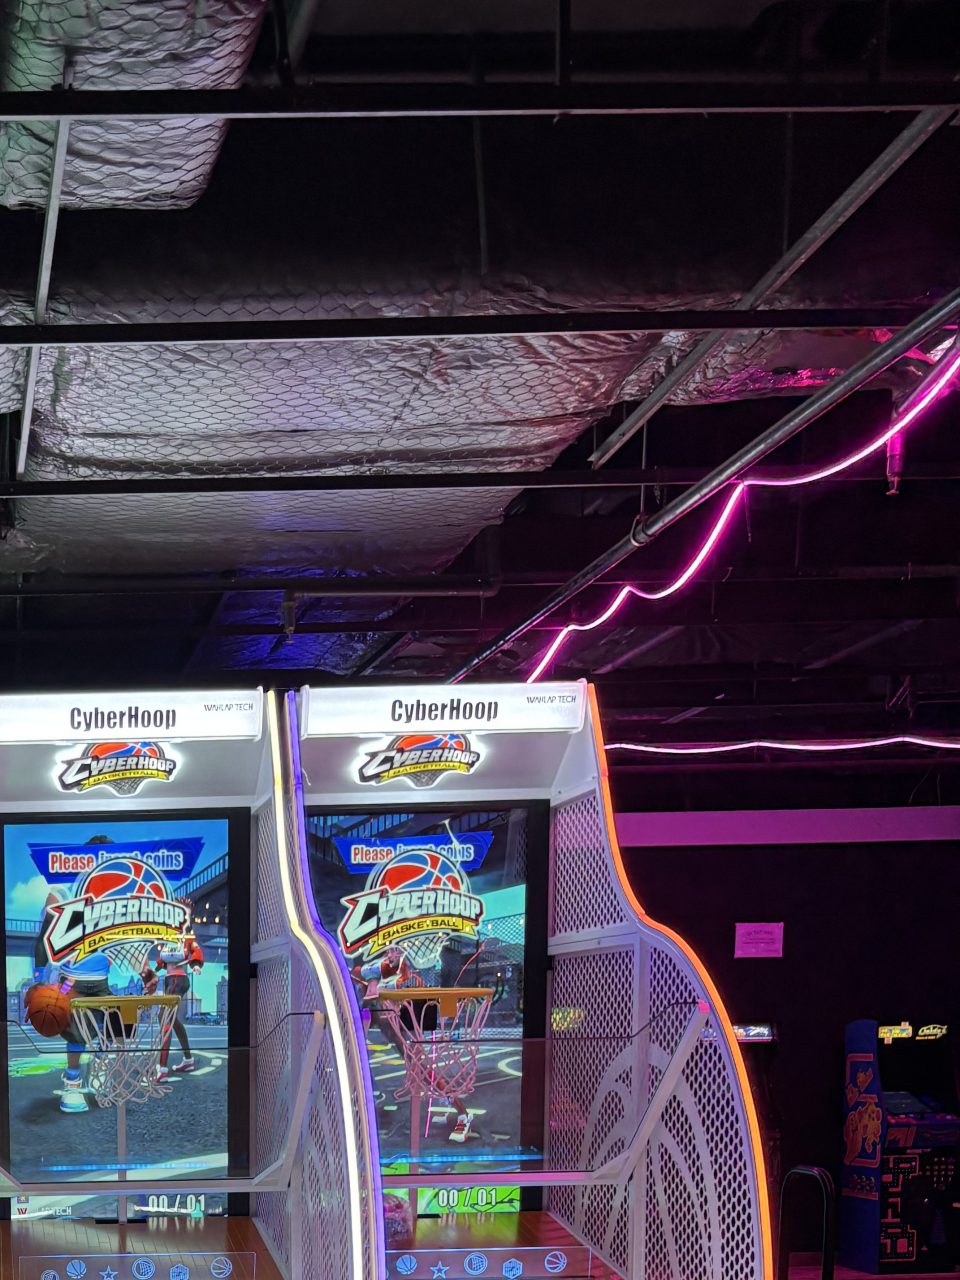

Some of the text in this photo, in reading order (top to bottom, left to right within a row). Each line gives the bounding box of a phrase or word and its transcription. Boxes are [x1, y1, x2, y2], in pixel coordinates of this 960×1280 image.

[234, 702, 254, 711] TECH
[558, 693, 577, 703] TECH
[69, 705, 177, 731] CyberHoop
[393, 698, 499, 723] CyberHoop
[50, 853, 94, 872] Please
[145, 850, 183, 870] coins
[353, 846, 393, 863] Please
[49, 897, 185, 952] CYBERHOOP
[343, 889, 482, 943] CYBERHOOP
[87, 927, 163, 949] BAKETBALL
[438, 1188, 459, 1208] 00
[477, 1187, 498, 1207] 01
